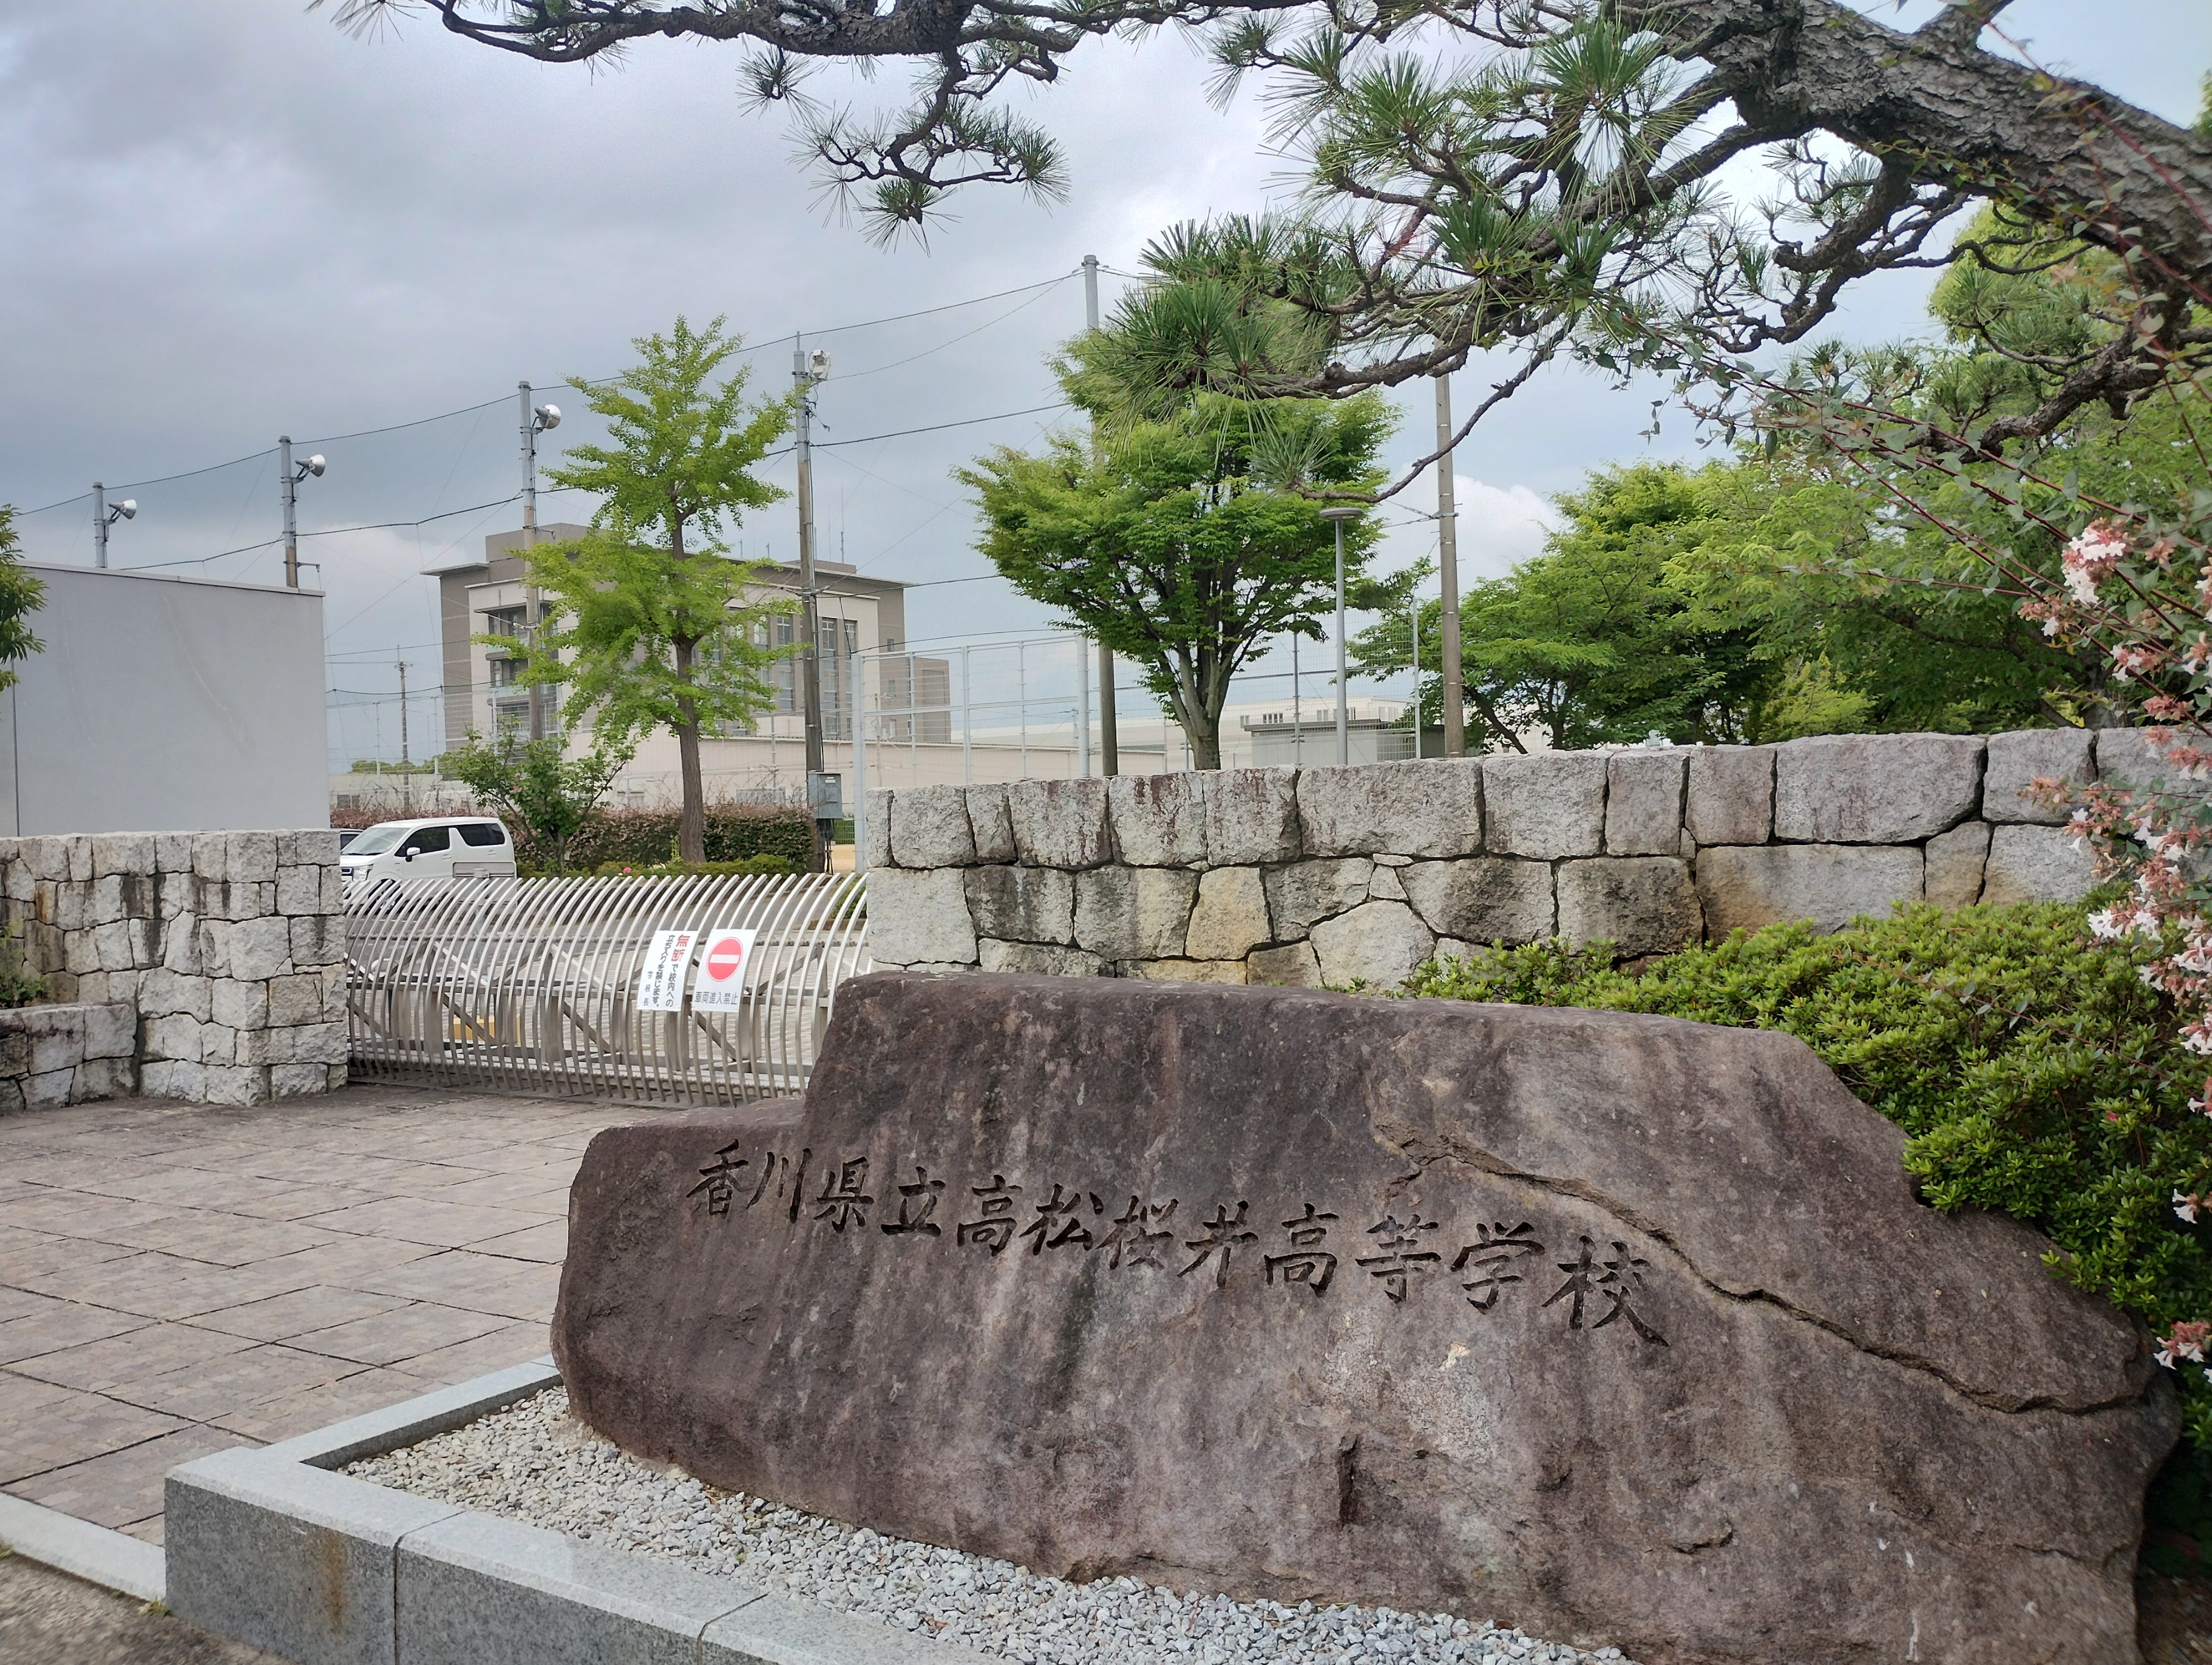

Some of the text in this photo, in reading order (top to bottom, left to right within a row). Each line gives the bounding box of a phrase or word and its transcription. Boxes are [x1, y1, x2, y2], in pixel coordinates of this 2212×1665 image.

[652, 934, 676, 1007] 立ち入りを禁じます。
[665, 934, 691, 1008] 無断で校内への
[694, 991, 738, 1005] 車両進入禁止
[685, 1138, 1671, 1348] 香川県立高松桜井高等学校
